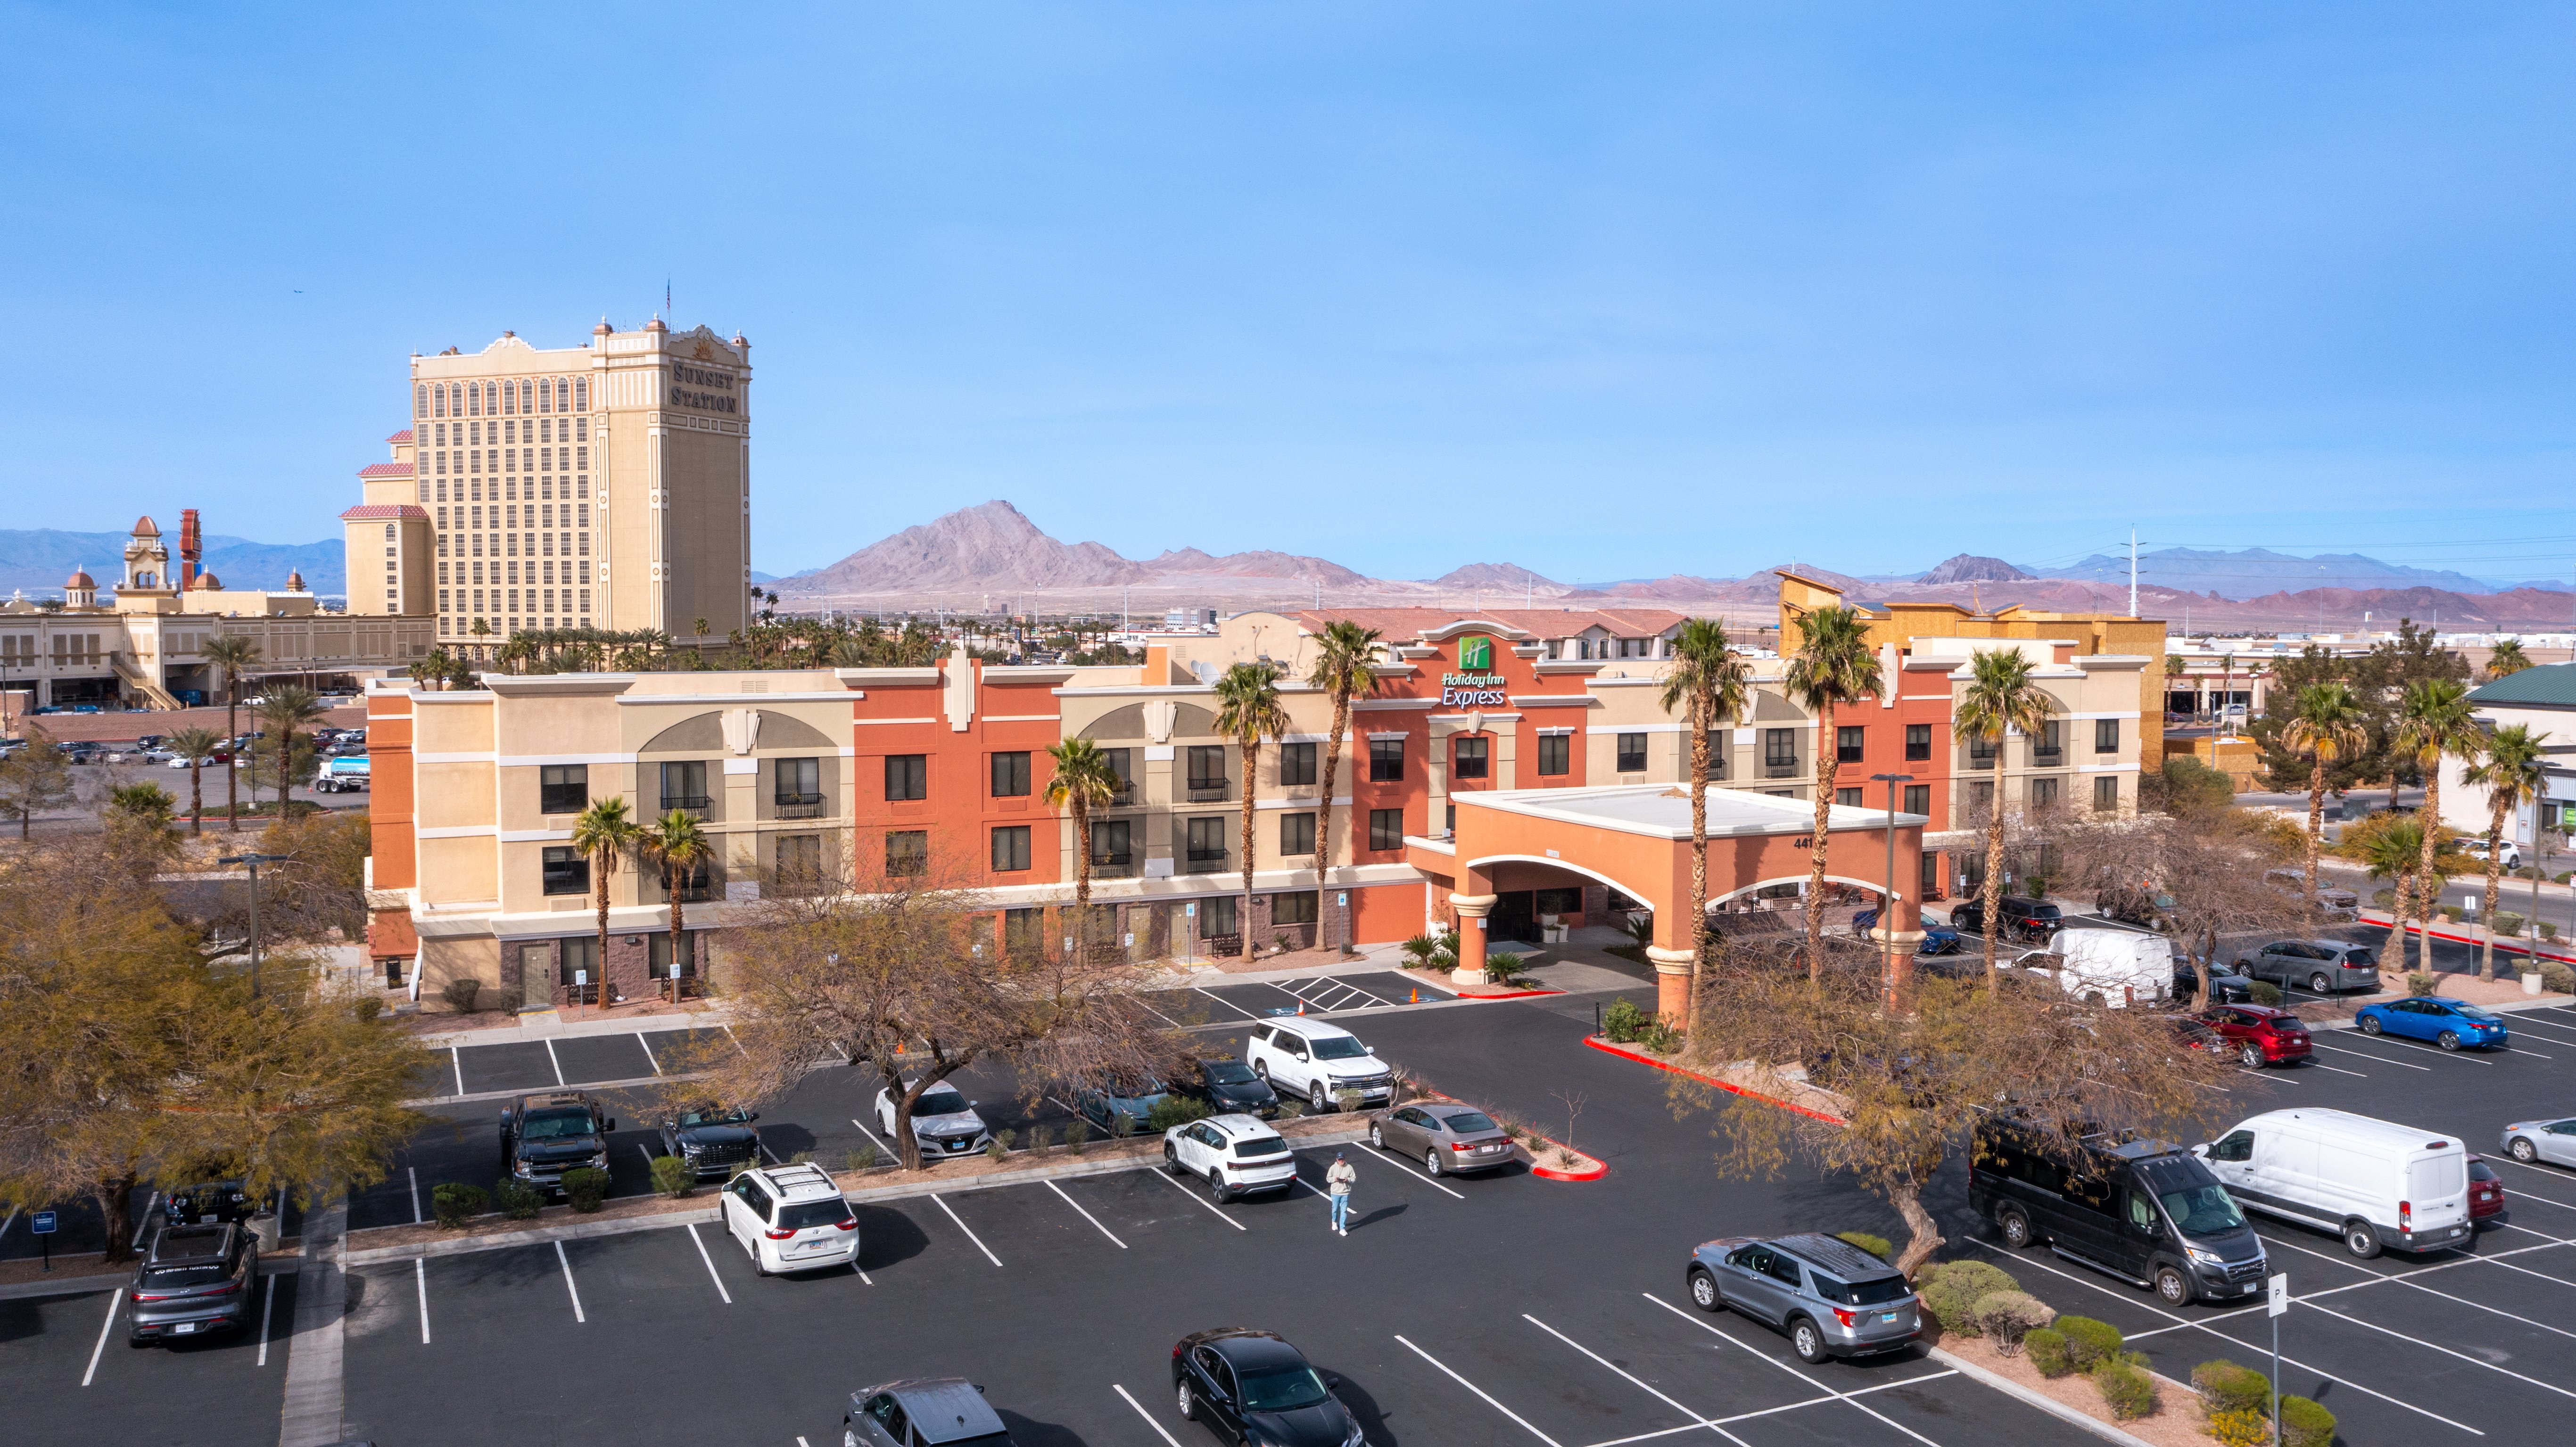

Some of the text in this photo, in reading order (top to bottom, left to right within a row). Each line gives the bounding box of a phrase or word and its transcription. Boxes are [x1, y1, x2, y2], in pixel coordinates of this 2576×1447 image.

[674, 362, 734, 389] SUNSET
[671, 386, 737, 413] STATION
[1441, 672, 1504, 688] Holiday Inn
[1441, 687, 1504, 710] Express
[2275, 1289, 2280, 1299] P
